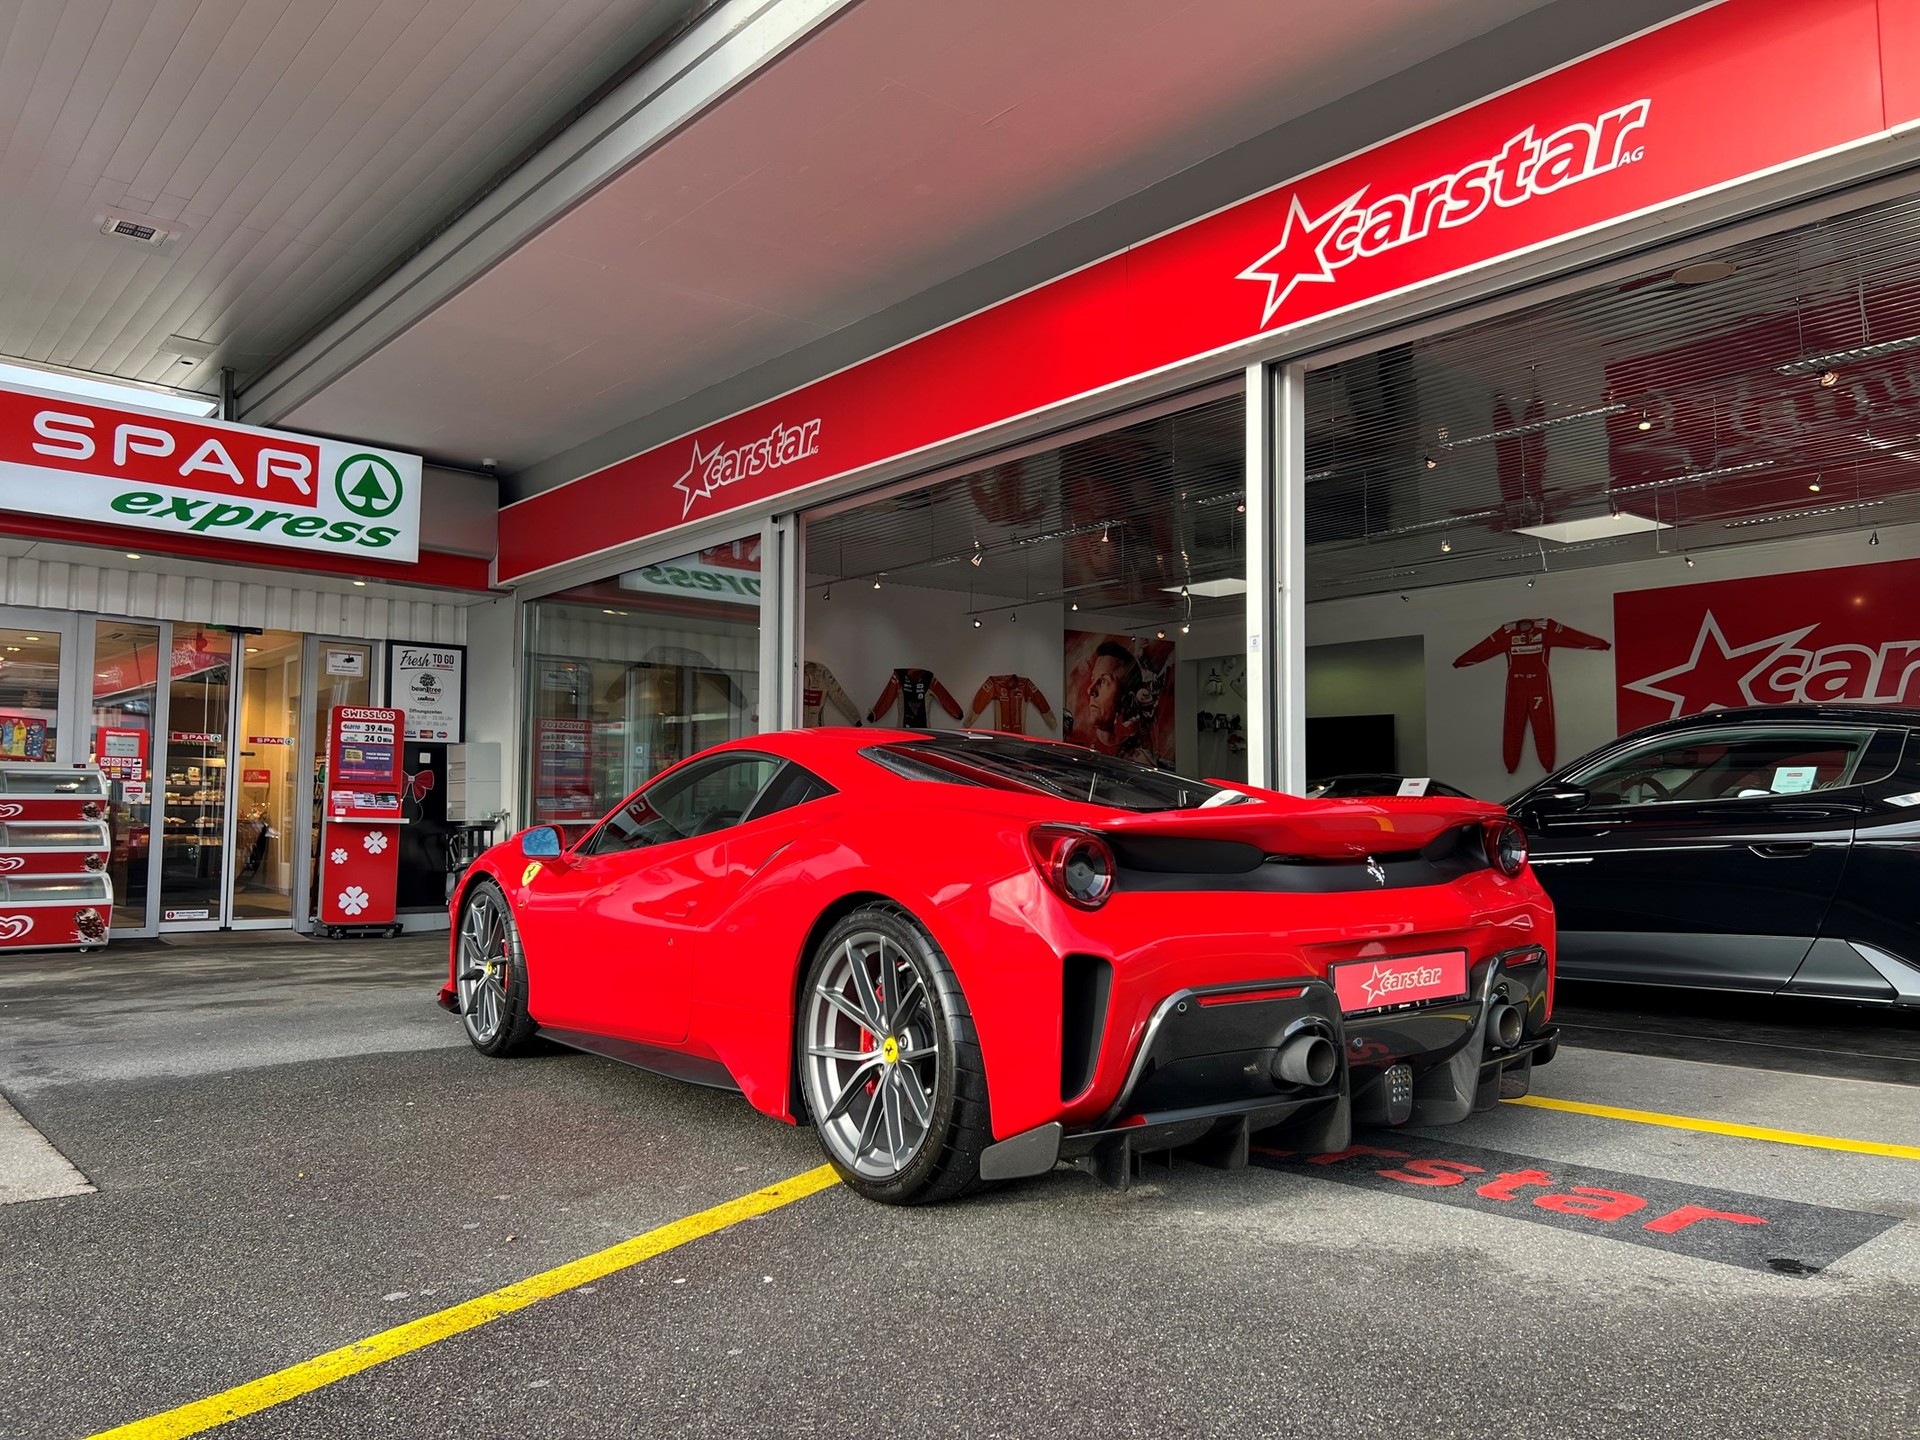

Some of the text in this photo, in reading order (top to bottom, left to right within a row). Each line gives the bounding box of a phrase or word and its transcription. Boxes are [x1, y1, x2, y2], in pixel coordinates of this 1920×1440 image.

[1315, 98, 1651, 269] carstar AG
[32, 410, 312, 495] SPAR
[704, 418, 821, 490] carstar
[110, 491, 401, 548] express
[400, 650, 454, 667] Fresh TO GO
[342, 709, 395, 720] SWISSLOS
[1380, 966, 1442, 991] carstar
